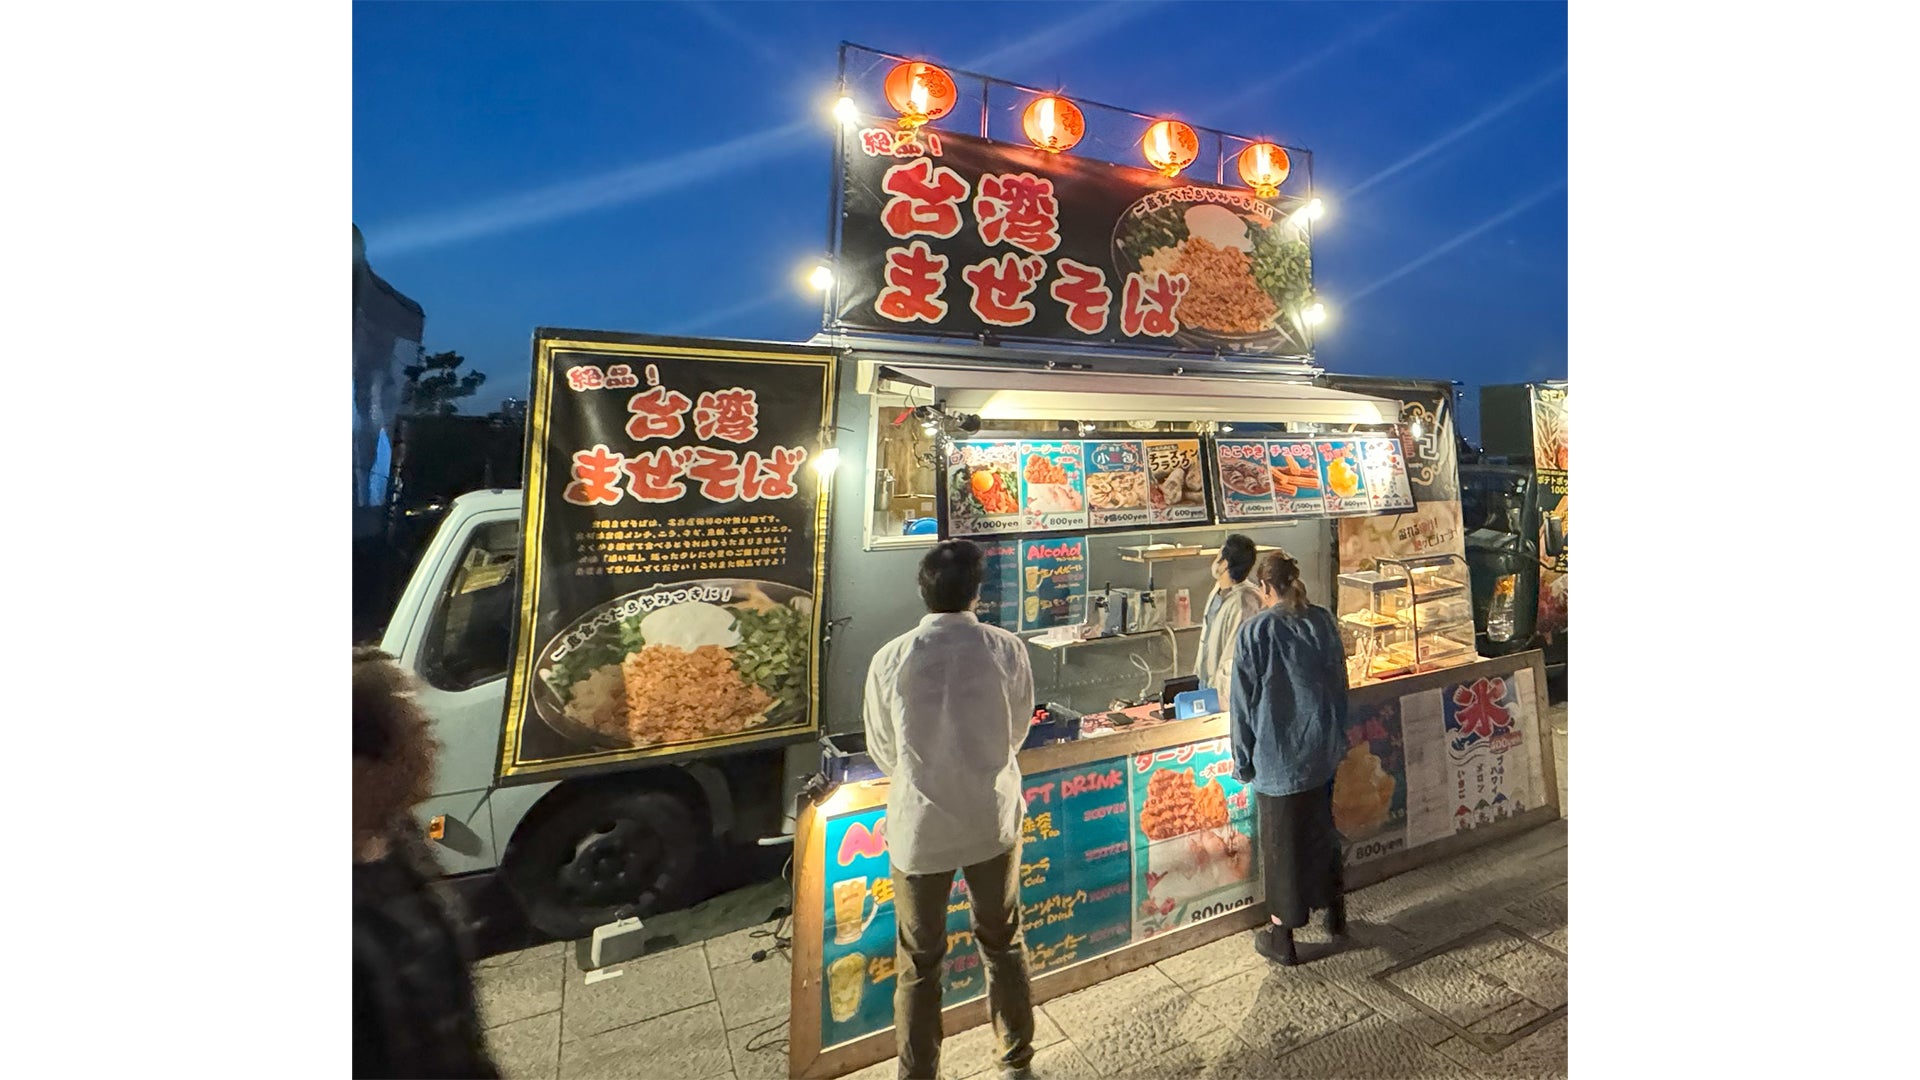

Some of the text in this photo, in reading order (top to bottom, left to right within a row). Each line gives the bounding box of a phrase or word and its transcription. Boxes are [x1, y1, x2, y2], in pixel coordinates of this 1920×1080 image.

[881, 157, 1061, 255] 台湾
[875, 241, 1190, 338] まぜそば
[626, 386, 758, 443] 台湾
[1219, 445, 1265, 459] たこやき
[1270, 445, 1313, 457] チュロス
[563, 444, 807, 506] まぜそば
[977, 520, 1020, 531] 1000yen
[1050, 516, 1084, 528] 800yen
[1027, 542, 1082, 561] Alcohol
[1453, 676, 1511, 738] 氷
[1061, 769, 1122, 800] DRINK
